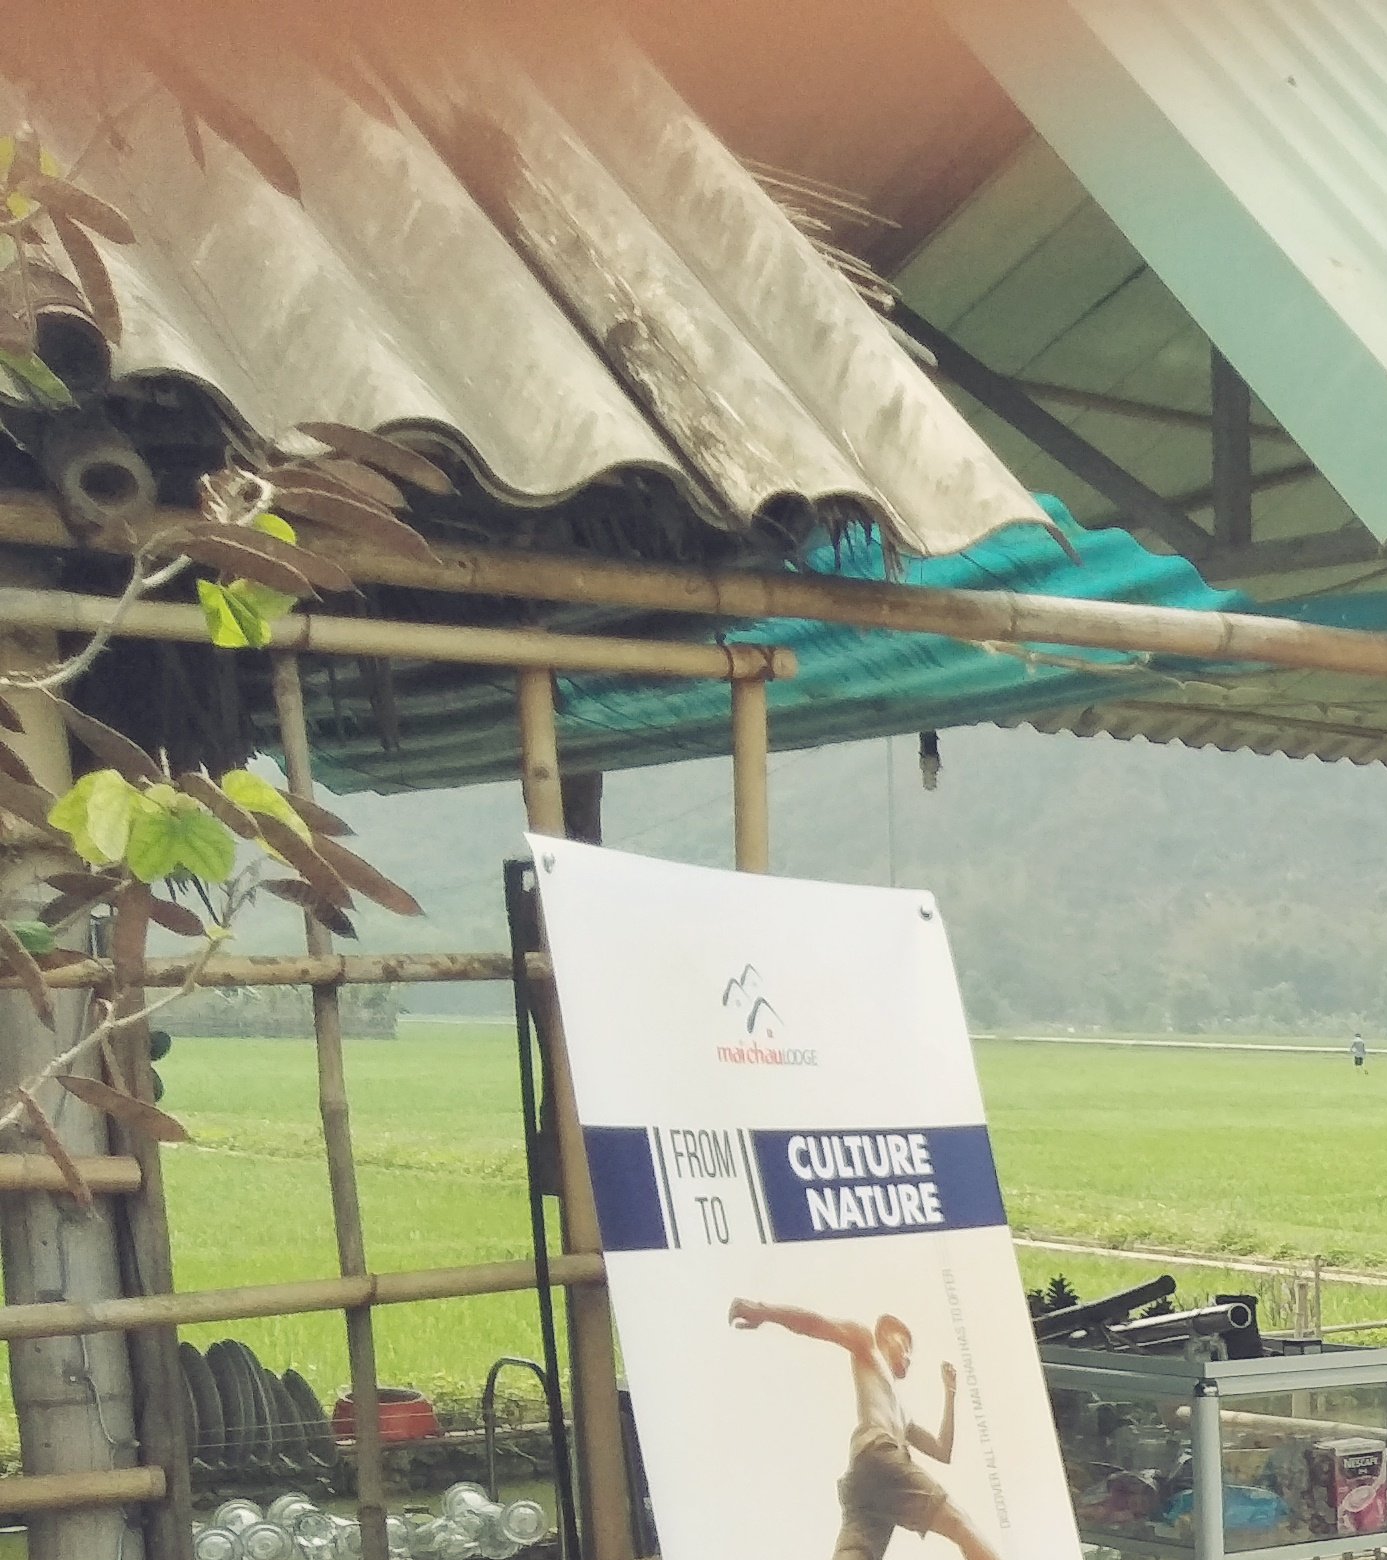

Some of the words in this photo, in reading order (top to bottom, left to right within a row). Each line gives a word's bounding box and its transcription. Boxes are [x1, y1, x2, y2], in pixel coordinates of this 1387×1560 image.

[669, 1128, 738, 1179] FROM
[786, 1133, 934, 1182] CULTURE
[694, 1196, 730, 1246] TO
[805, 1182, 944, 1233] NATURE
